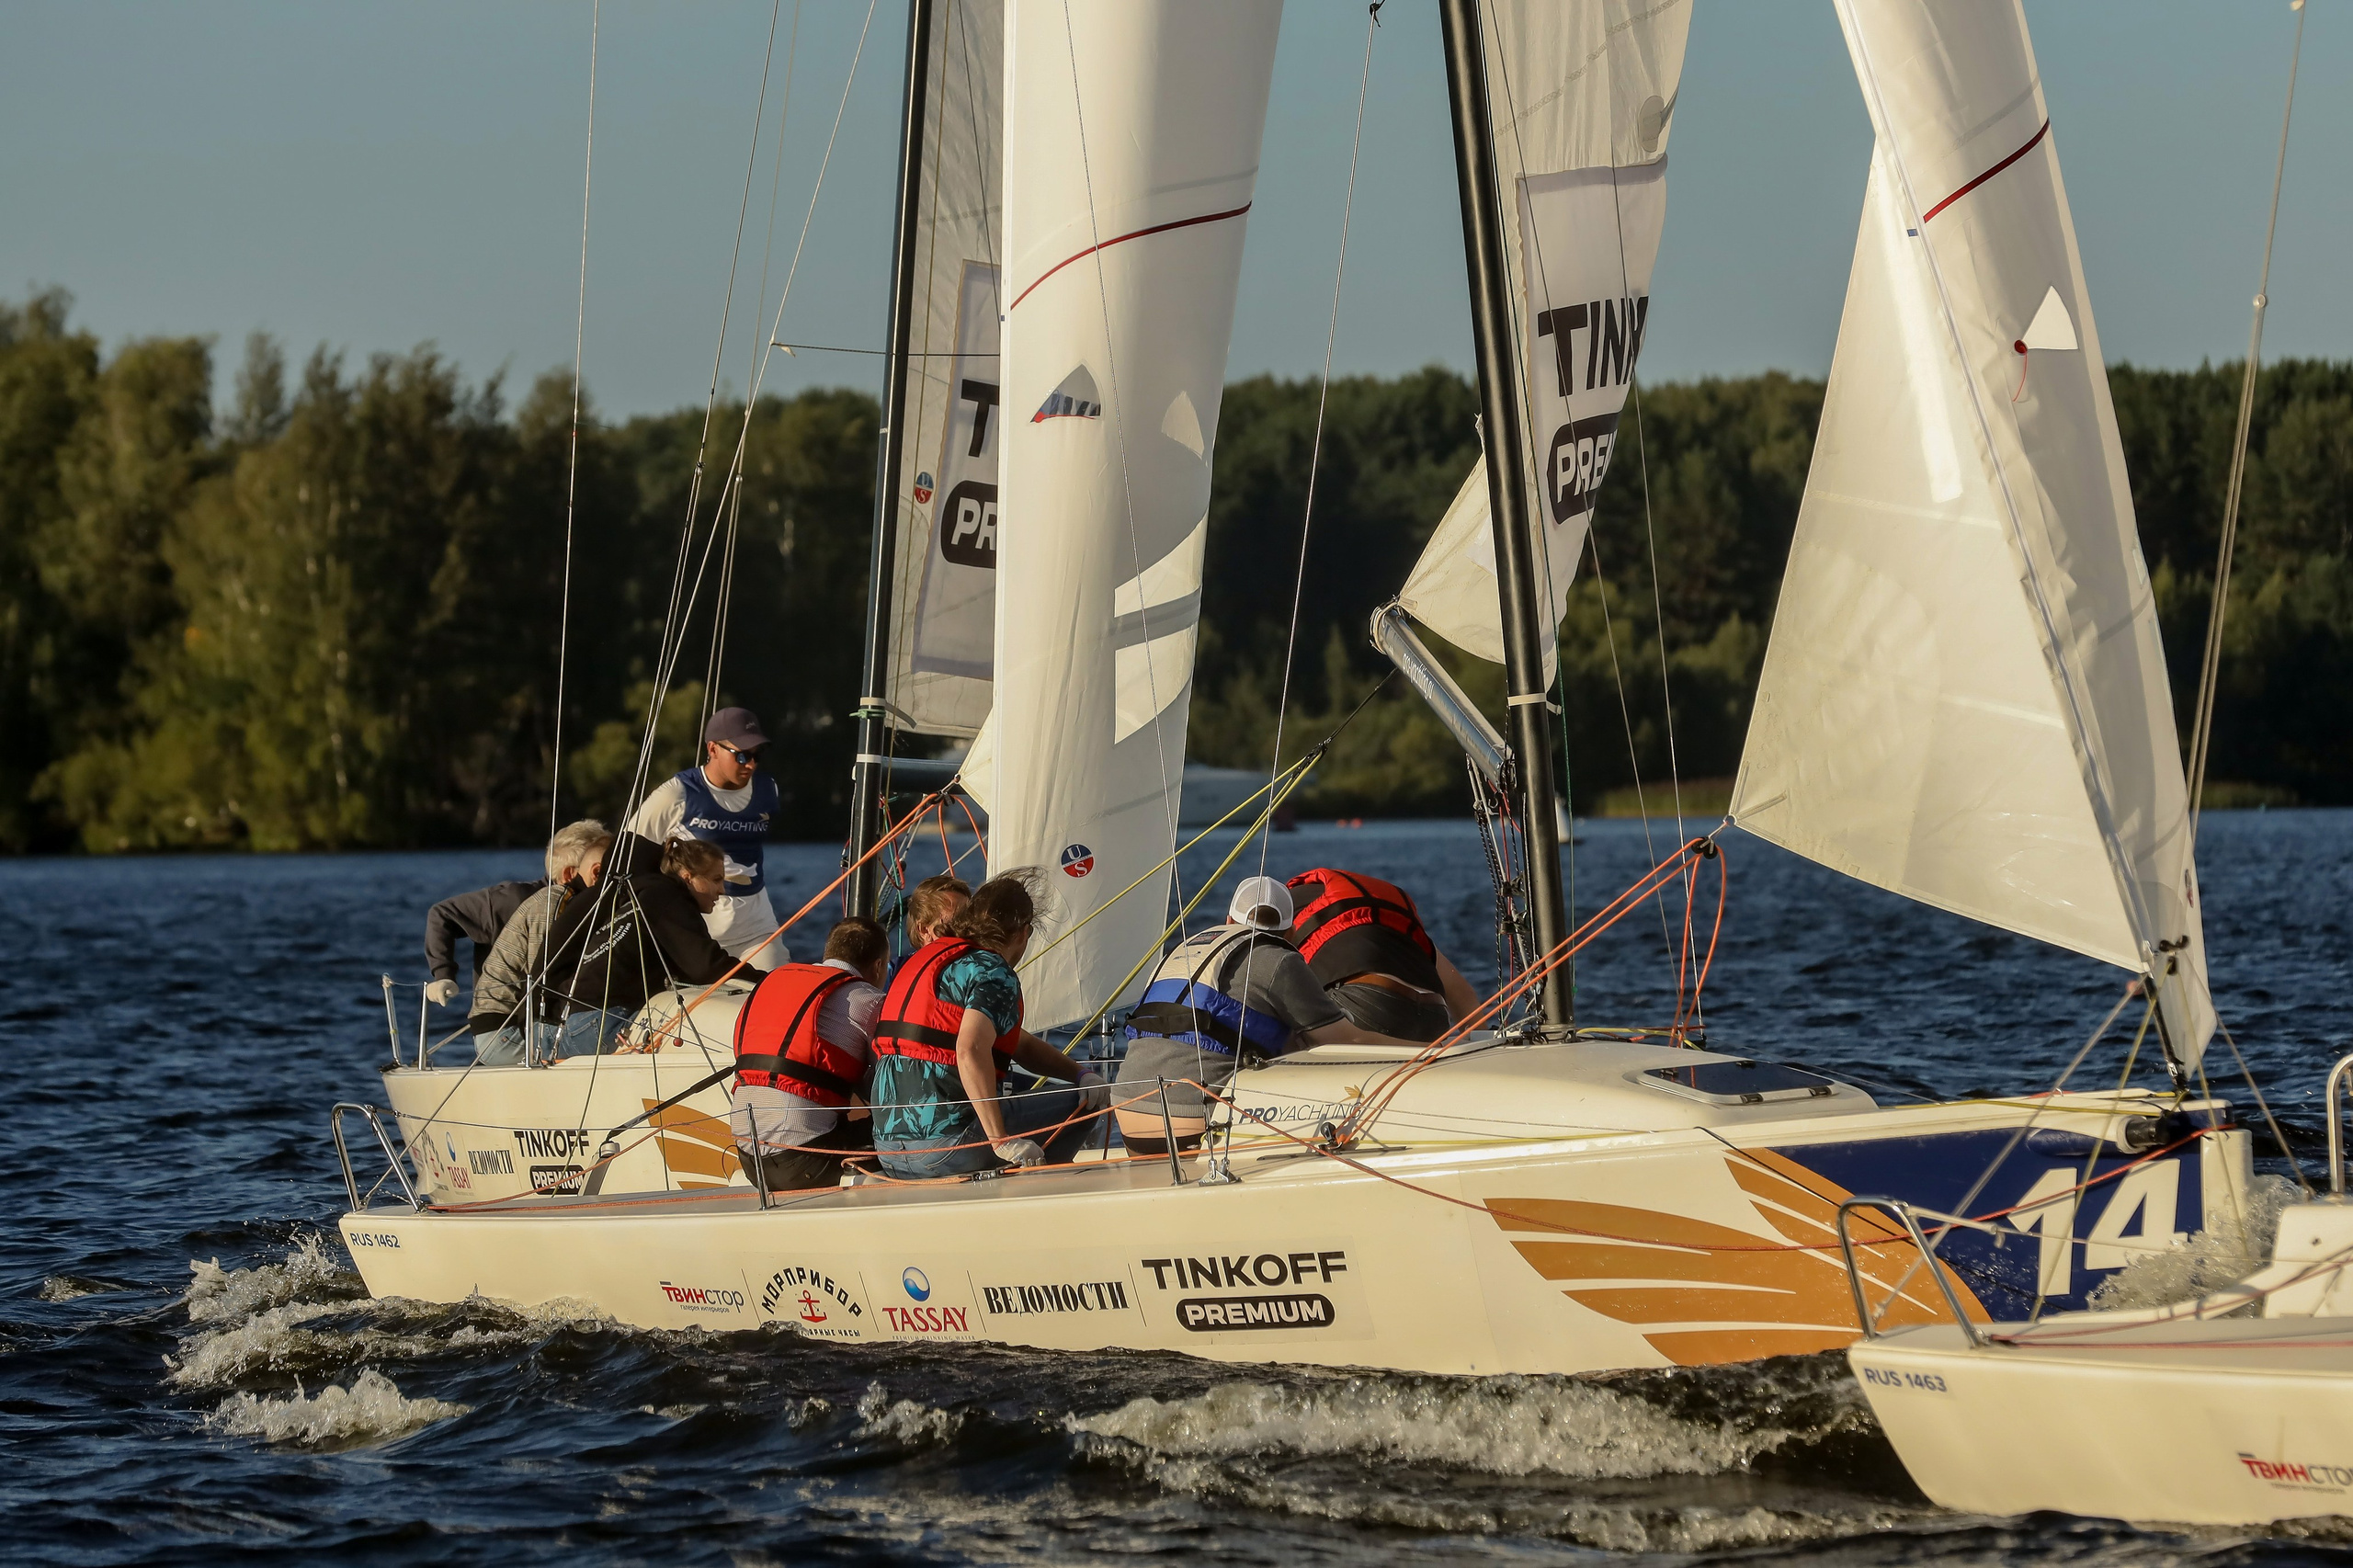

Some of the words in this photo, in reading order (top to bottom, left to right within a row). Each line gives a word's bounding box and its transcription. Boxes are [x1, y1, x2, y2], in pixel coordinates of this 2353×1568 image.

[513, 1130, 589, 1158] TINKOFF
[467, 1150, 515, 1176] ВЕДОМОСТИ
[532, 1169, 585, 1190] PREMIUM
[2007, 1158, 2188, 1296] 14
[350, 1233, 374, 1247] RUS
[374, 1233, 401, 1248] 1462
[1141, 1250, 1348, 1290] TINKOFF
[761, 1267, 863, 1318] МОРПРИБОР
[982, 1281, 1131, 1317] ВЕДОМОСТИ
[882, 1307, 970, 1332] TASSAY
[1186, 1299, 1327, 1326] PREMIUM
[806, 1328, 835, 1336] АРНЫЕ
[1864, 1367, 1903, 1388] RUS
[1904, 1372, 1948, 1392] 1463
